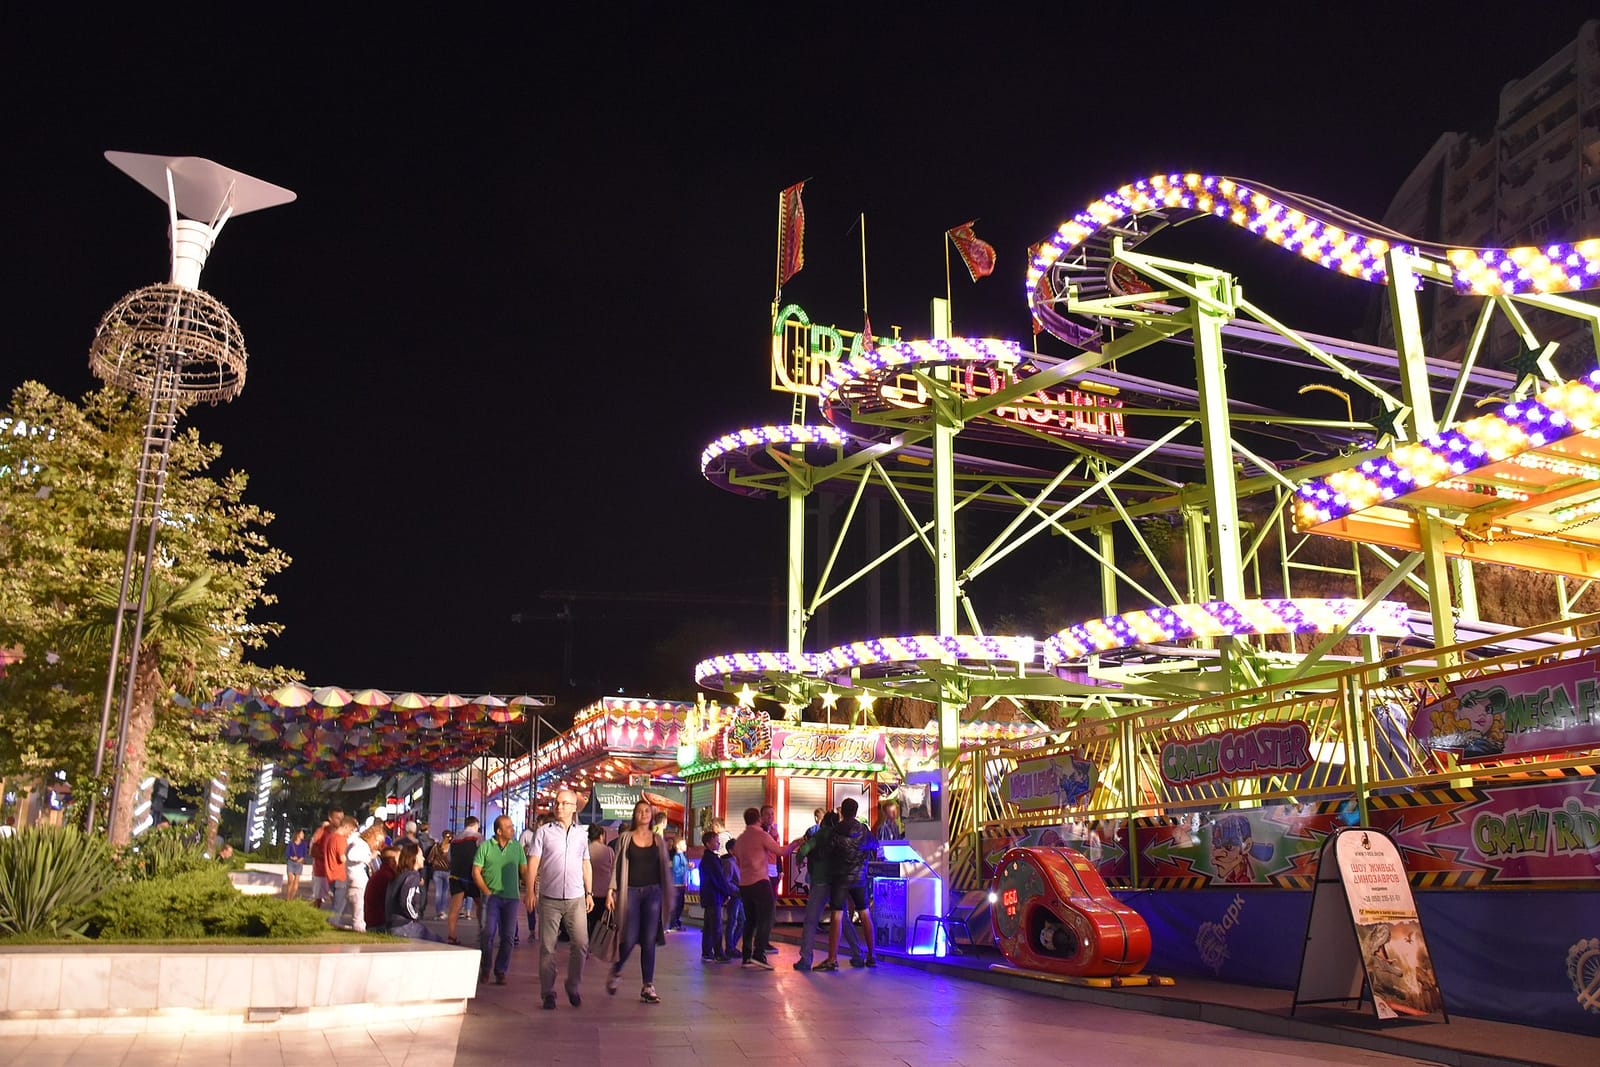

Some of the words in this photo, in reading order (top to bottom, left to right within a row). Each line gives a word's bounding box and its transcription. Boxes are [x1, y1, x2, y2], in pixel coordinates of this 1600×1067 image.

[1506, 684, 1575, 734] MEGA
[779, 734, 876, 764] Swinging
[1163, 741, 1219, 781] CRAZY
[1219, 726, 1308, 772] COASTER
[1474, 810, 1549, 854] CRAZY
[1351, 864, 1367, 873] ШОУ
[1368, 864, 1396, 873] ЖИВЫХ
[1353, 874, 1400, 884] ДИНОЗАВРОВ
